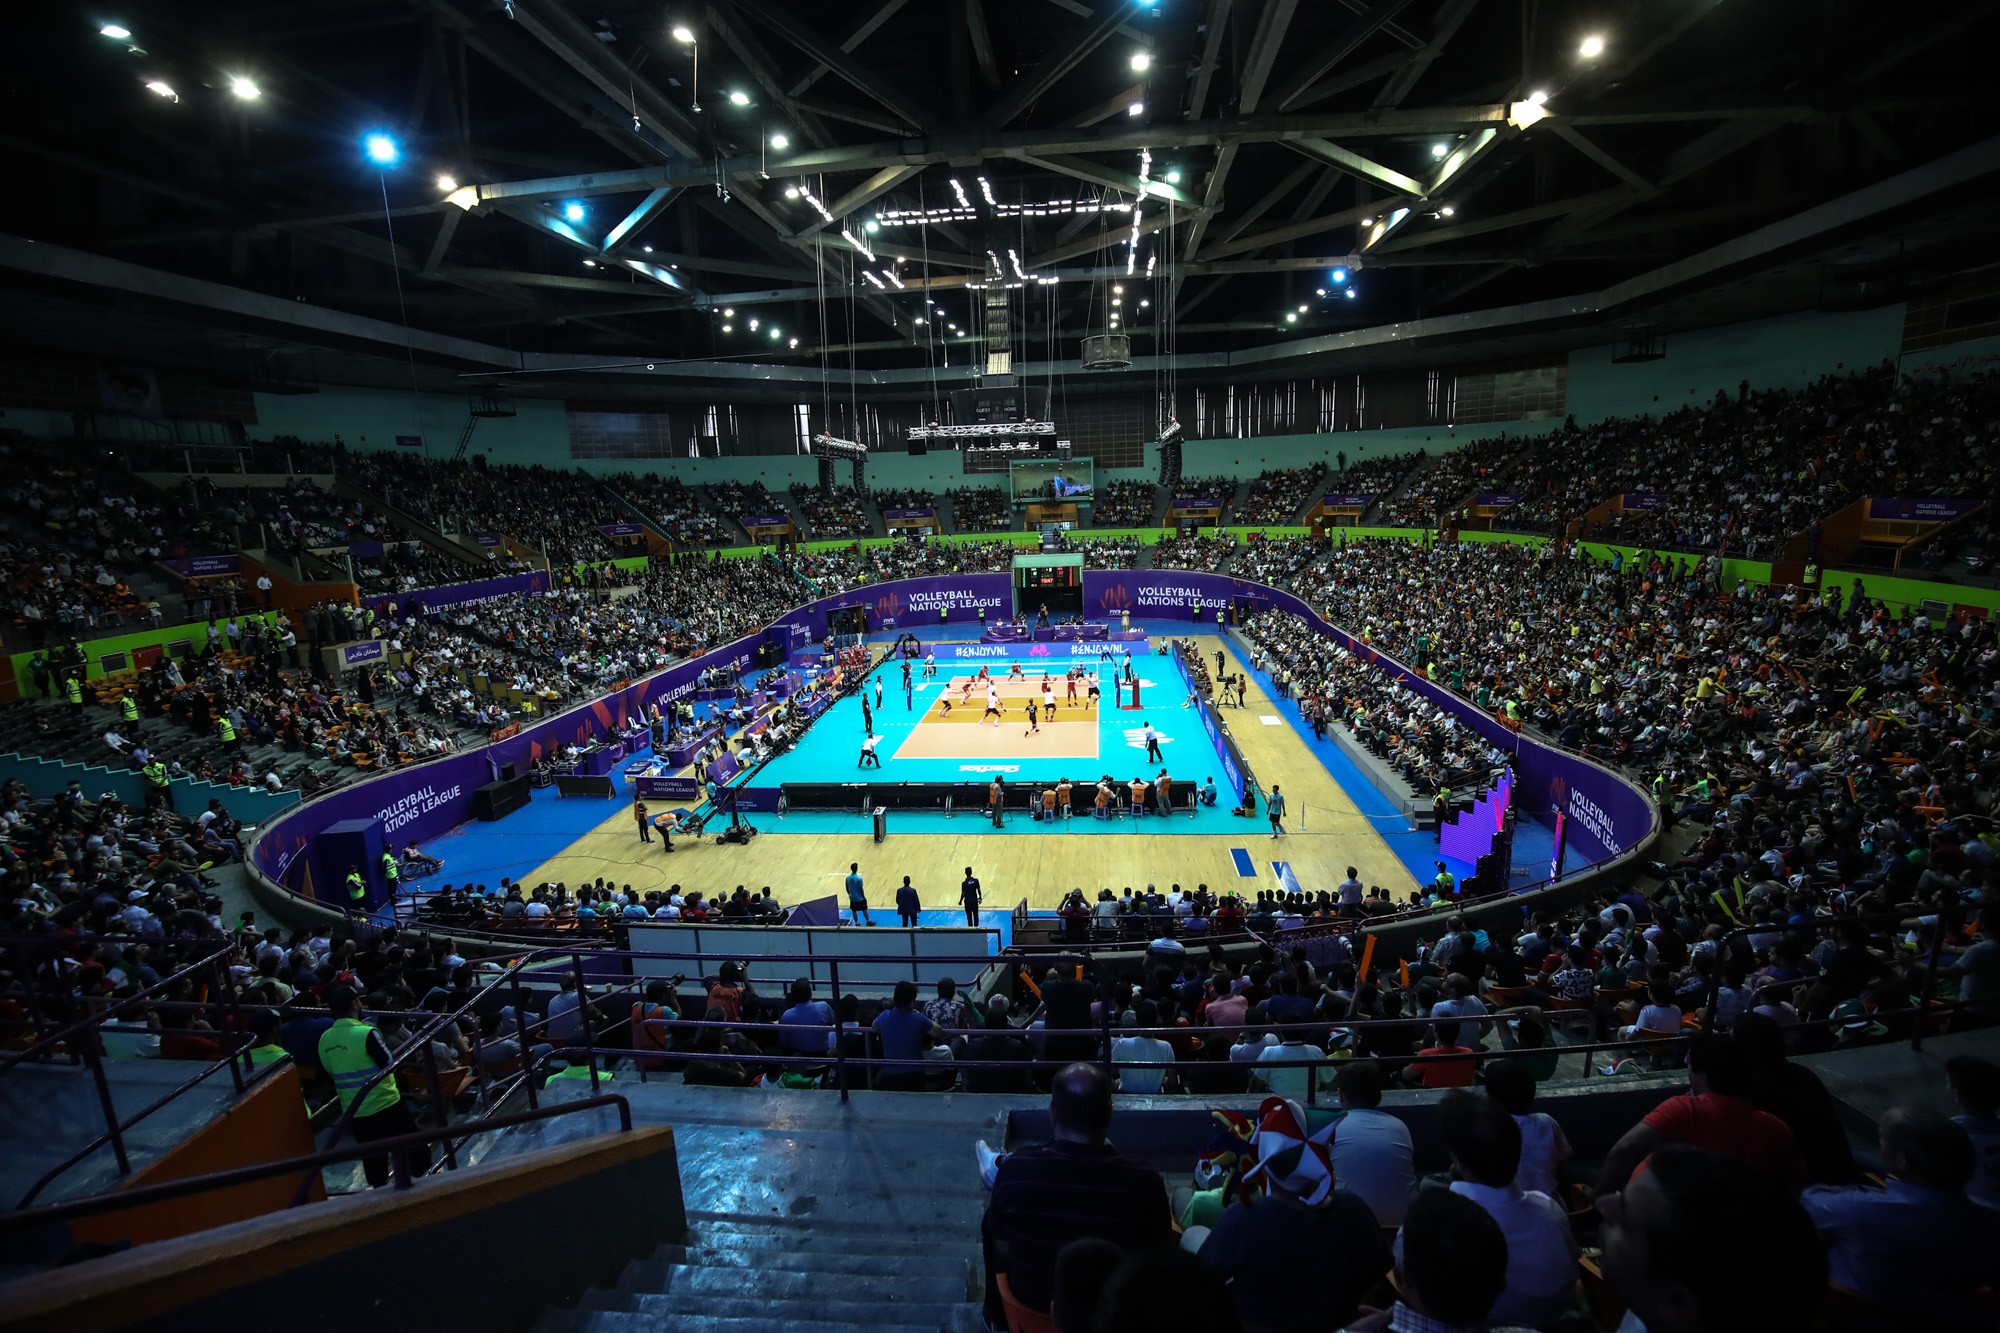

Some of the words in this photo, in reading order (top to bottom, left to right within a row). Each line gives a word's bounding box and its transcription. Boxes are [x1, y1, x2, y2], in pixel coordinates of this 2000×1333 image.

[909, 590, 974, 602] VOLLEYBALL
[1138, 588, 1202, 598] VOLLEYBALL
[1138, 597, 1184, 606] NATIONS
[1188, 598, 1226, 609] LEAGUE
[910, 600, 956, 612] NATIONS
[960, 598, 1001, 608] LEAGUE
[658, 680, 696, 706] VOLLEYBALL
[384, 806, 420, 834] ATIONS
[422, 784, 461, 813] LEAGUE
[1571, 787, 1614, 836] VOLLEYBALL
[1569, 802, 1601, 839] NATIONS
